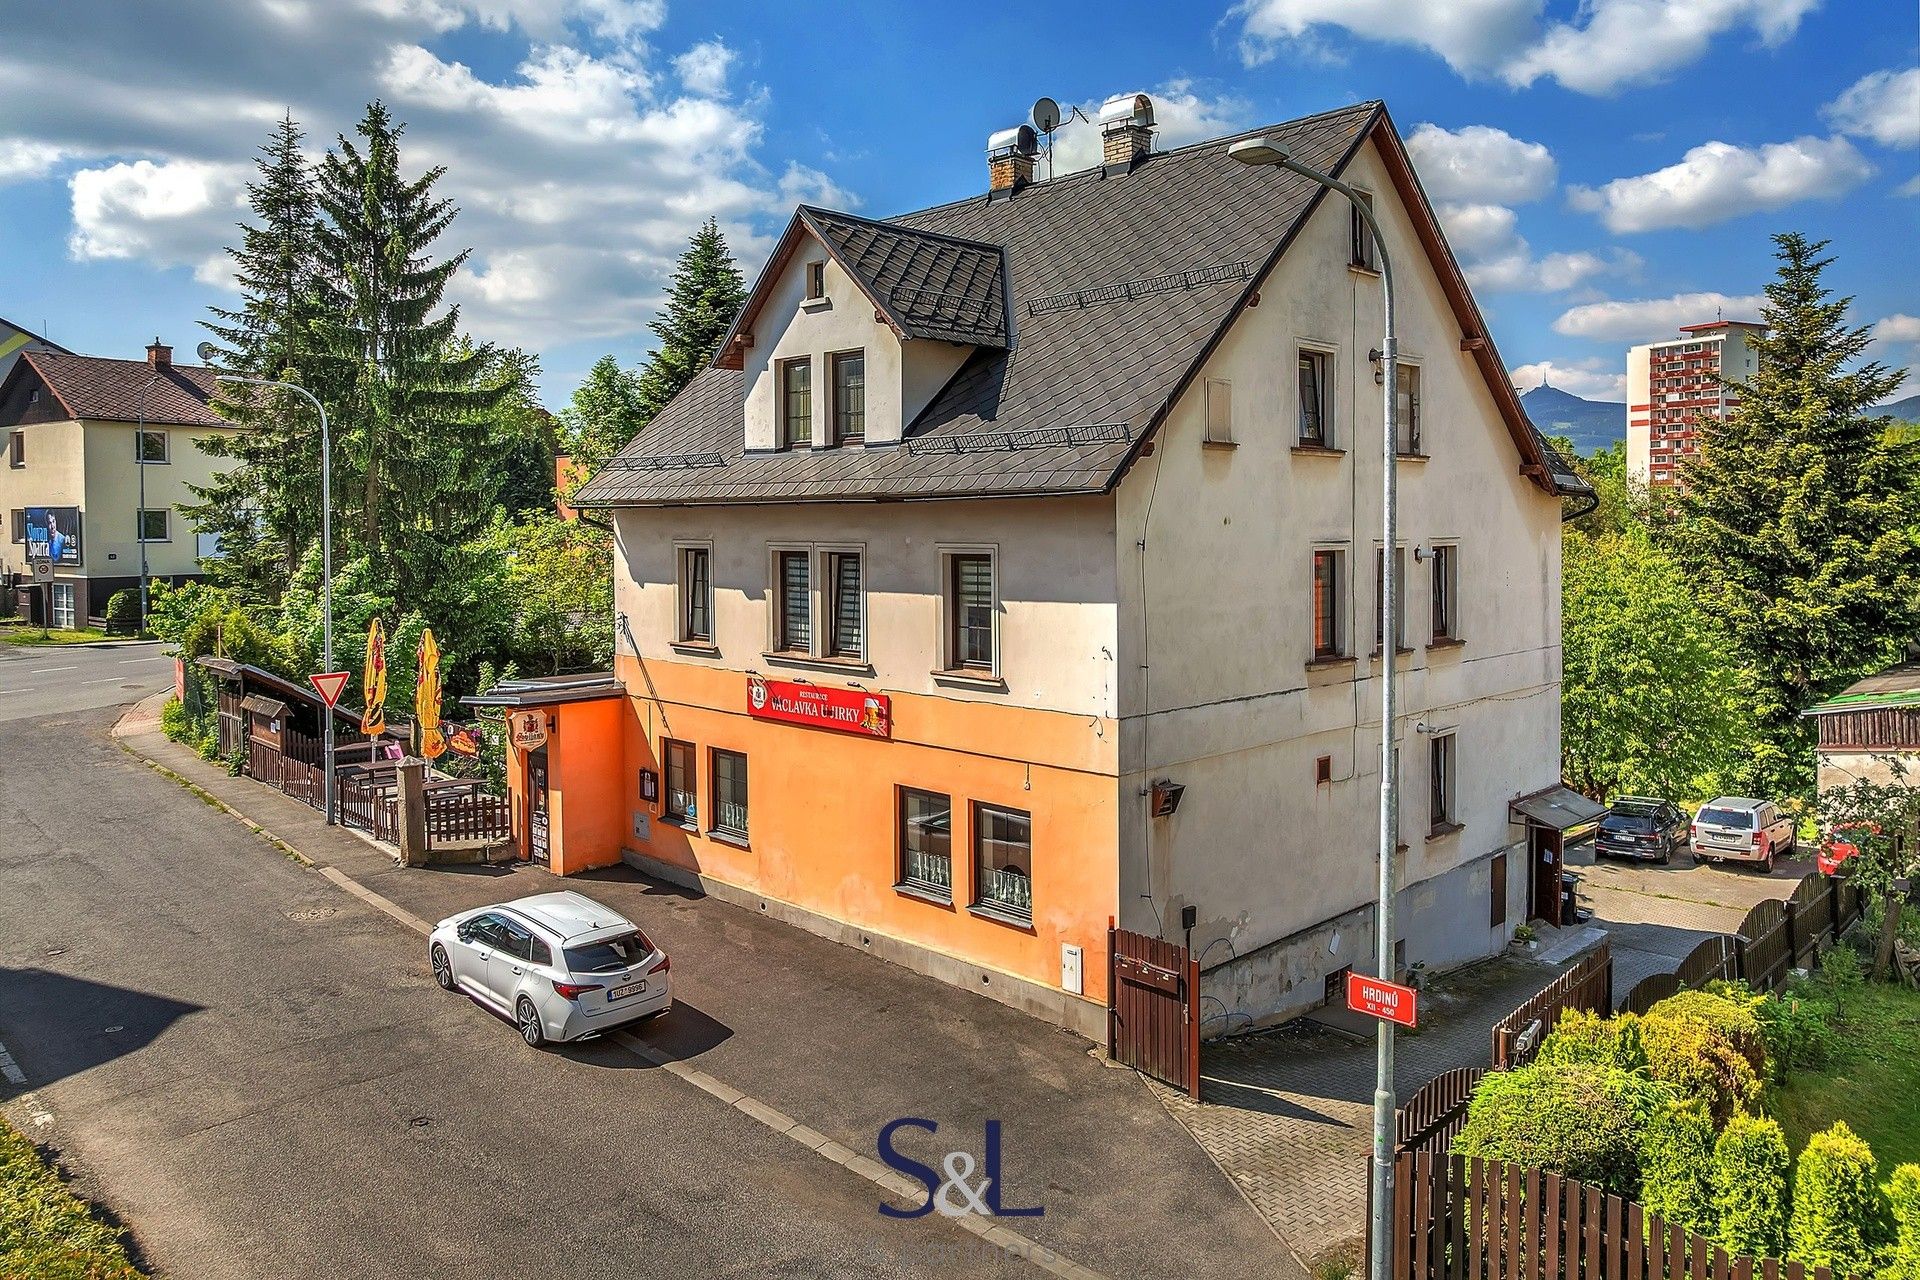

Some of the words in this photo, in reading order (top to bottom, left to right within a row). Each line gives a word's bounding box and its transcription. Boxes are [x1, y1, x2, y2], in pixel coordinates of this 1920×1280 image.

[28, 539, 50, 558] Sparta
[771, 695, 818, 717] VÁCLAVKA
[830, 705, 860, 723] JIRKY
[1362, 985, 1399, 1008] HRDINŮ
[1366, 1001, 1376, 1012] XII
[1382, 1006, 1395, 1017] 450
